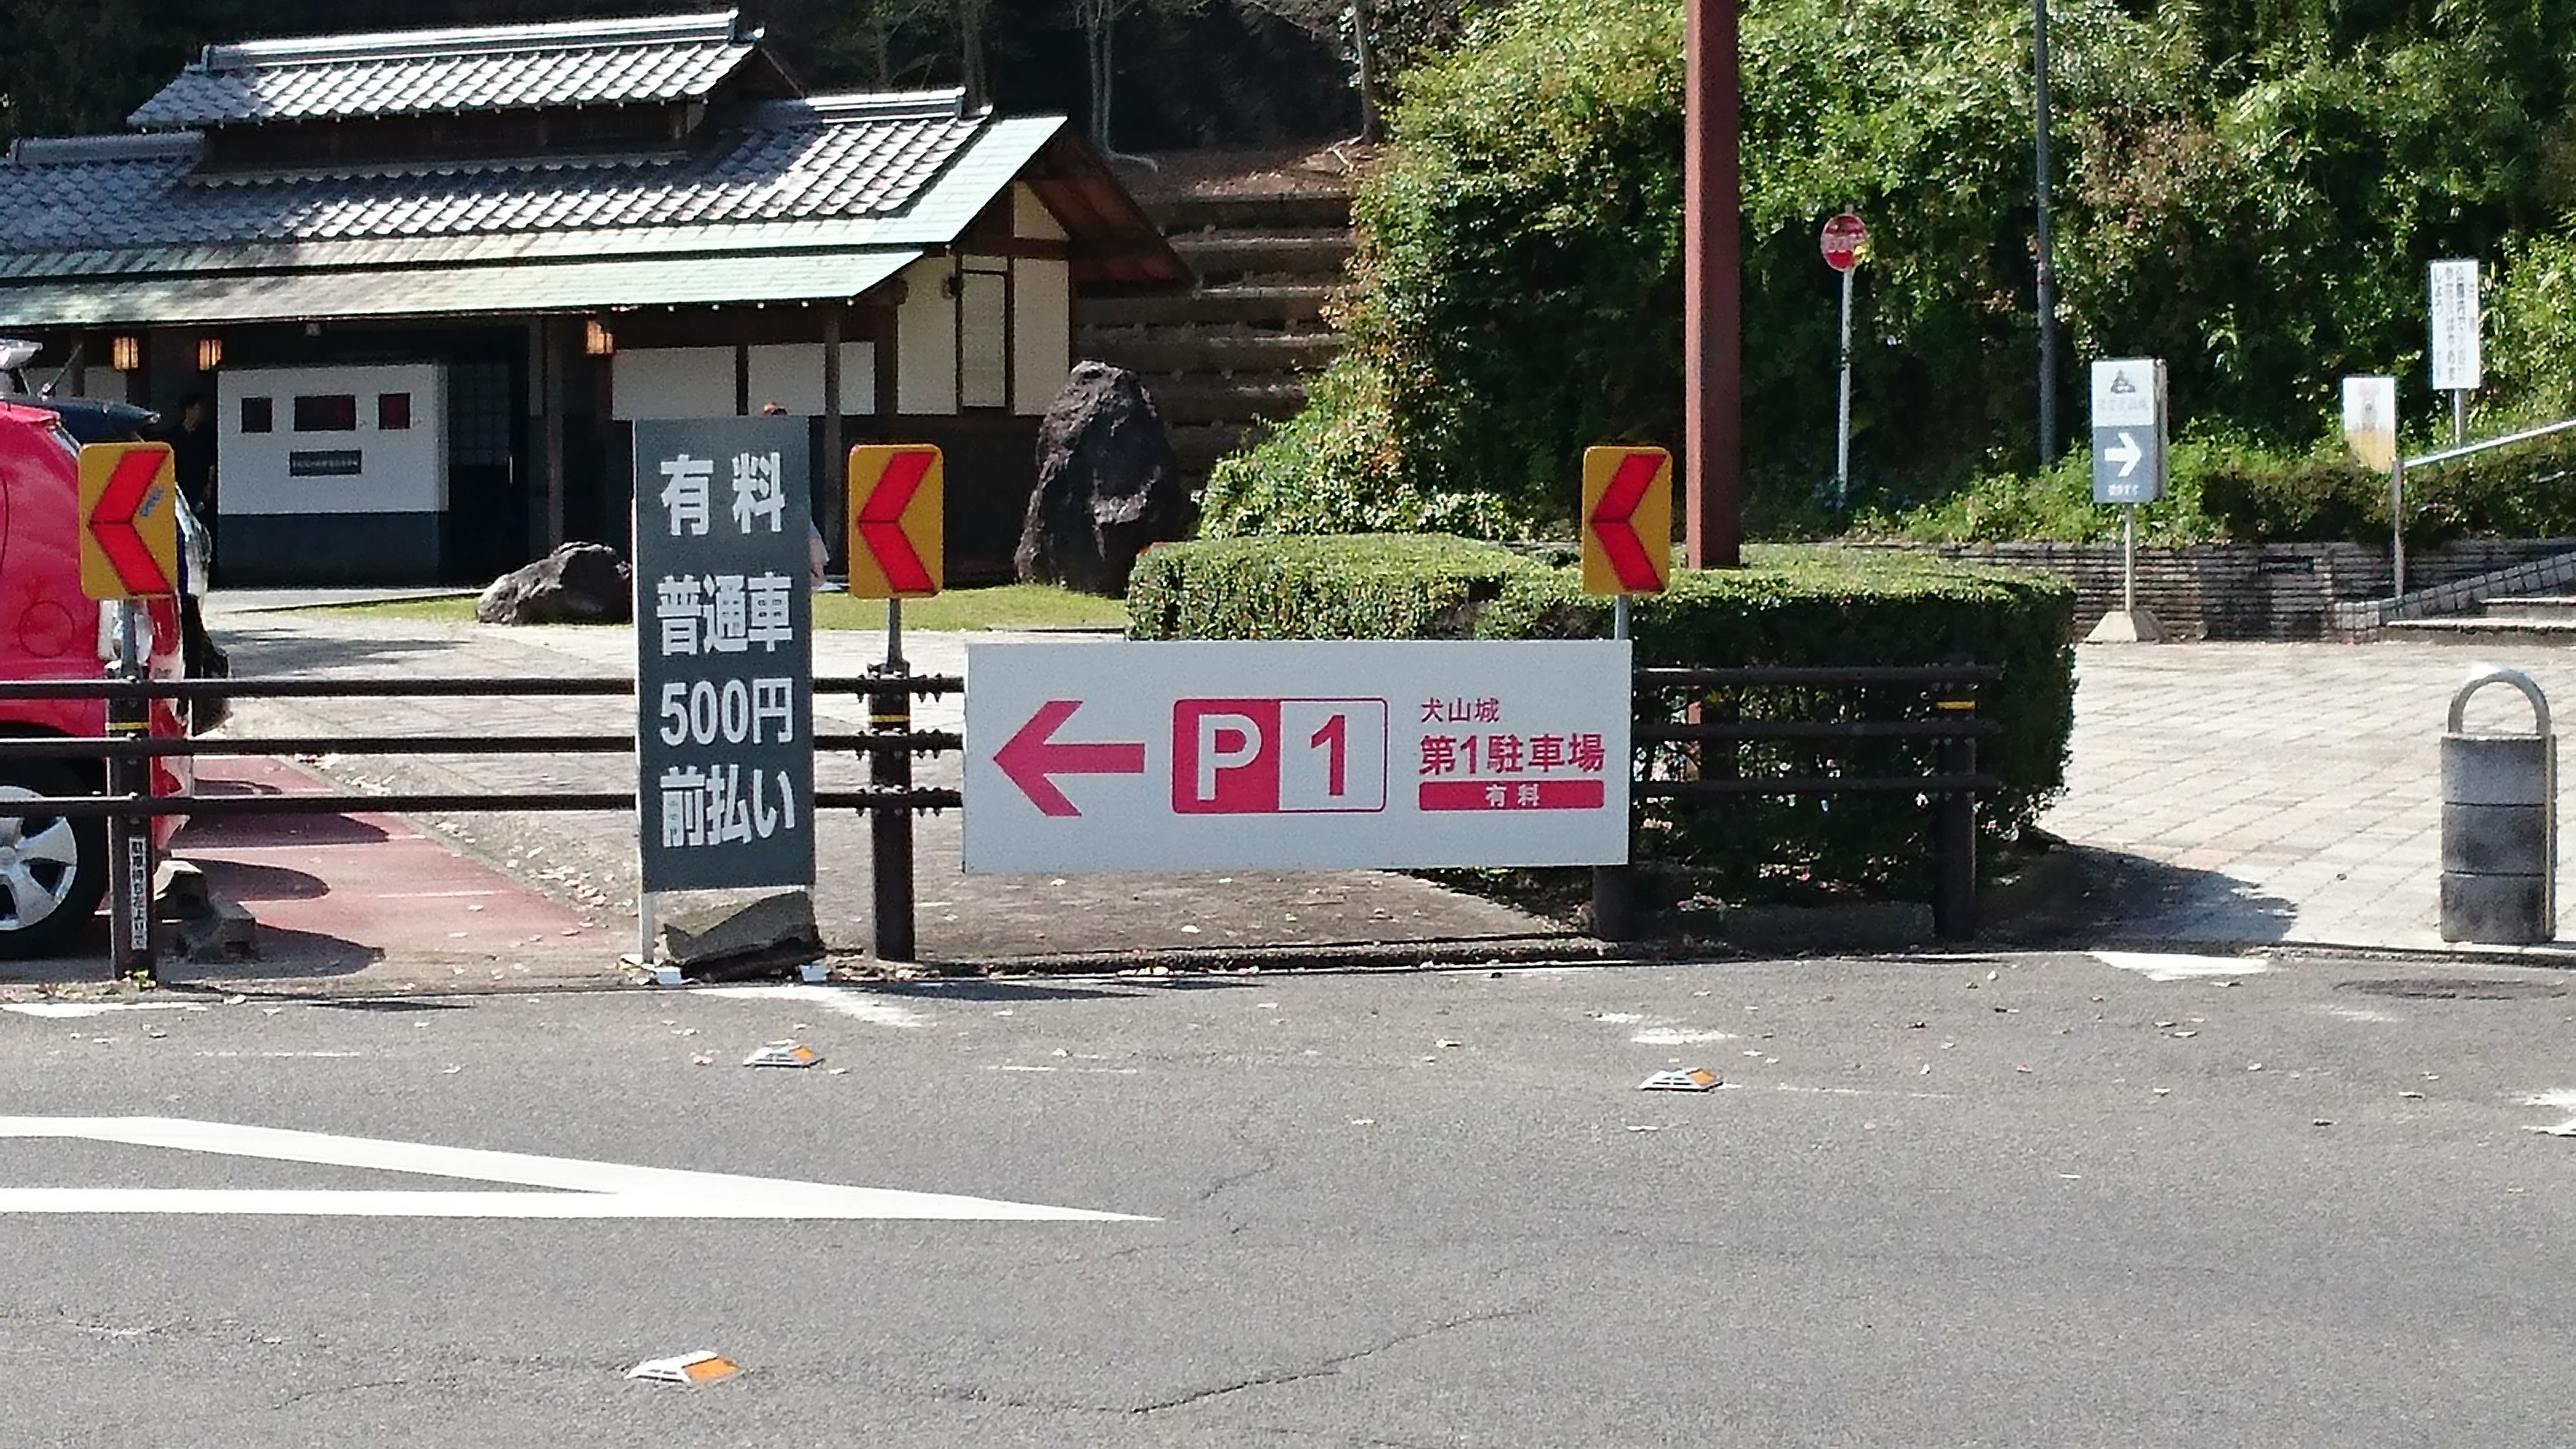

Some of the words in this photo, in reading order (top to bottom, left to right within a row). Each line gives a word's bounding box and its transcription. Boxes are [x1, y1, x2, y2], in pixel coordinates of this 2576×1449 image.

[660, 451, 786, 536] 有料
[657, 571, 793, 656] 普通車
[659, 677, 793, 746] 500円
[1421, 697, 1500, 723] 犬山城
[1197, 714, 1261, 800] P
[1310, 714, 1346, 796] 1
[1419, 733, 1605, 775] 第1駐車場
[659, 763, 795, 848] 前払い
[1485, 784, 1540, 807] 有料
